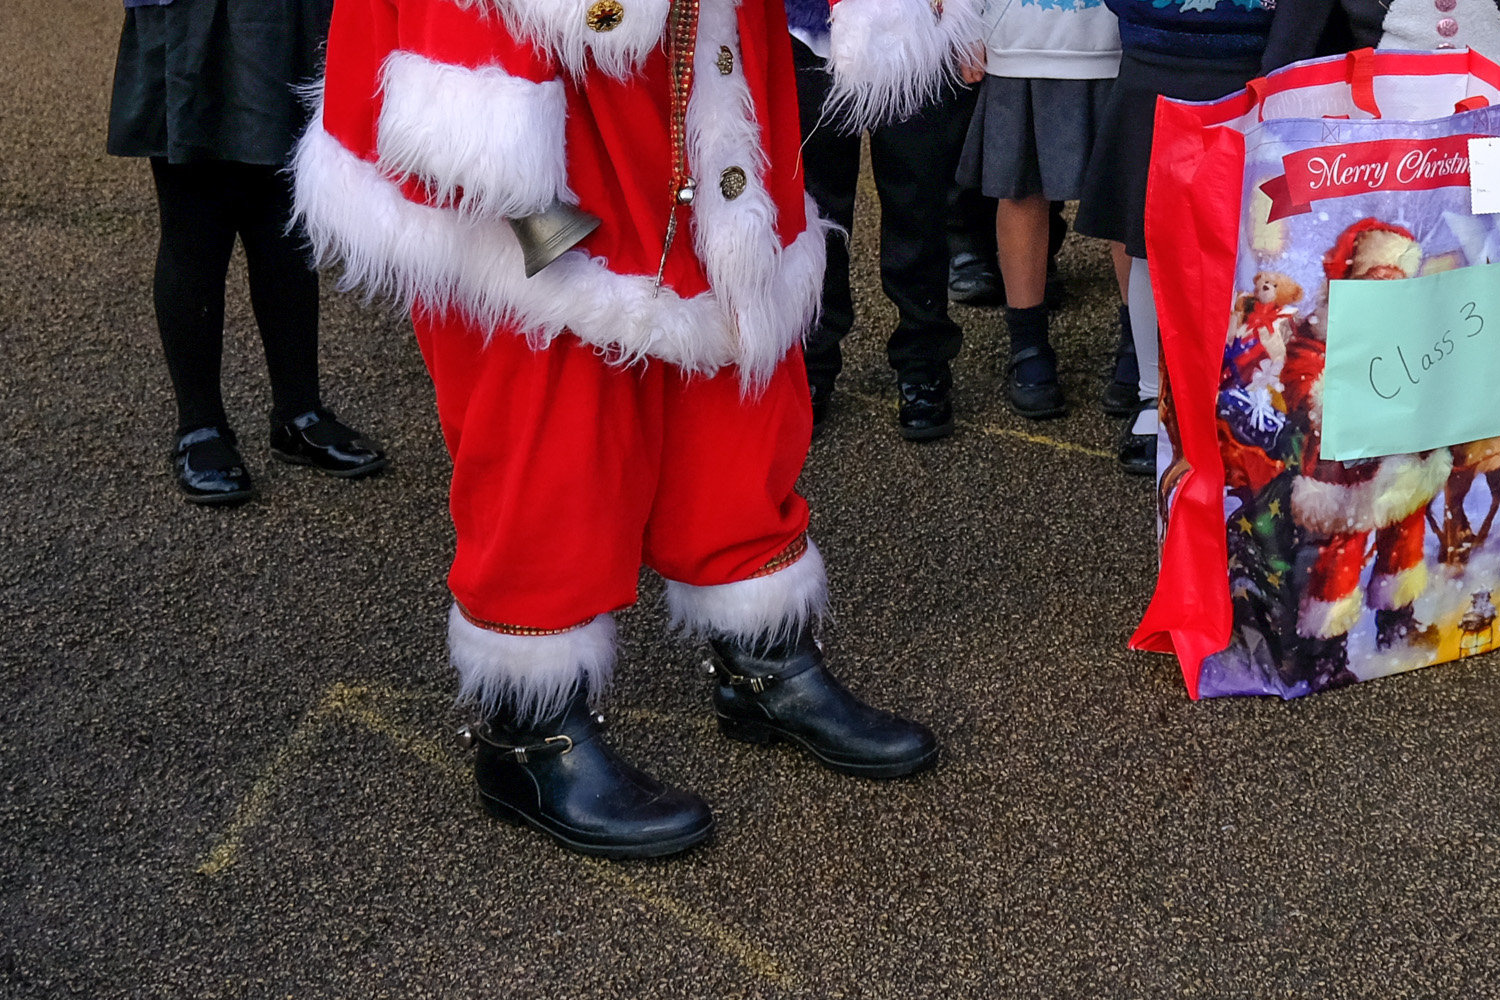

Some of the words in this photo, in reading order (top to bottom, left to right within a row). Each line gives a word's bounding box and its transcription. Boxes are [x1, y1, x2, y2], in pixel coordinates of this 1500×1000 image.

[1307, 153, 1389, 189] Merry
[1396, 148, 1471, 184] Christm
[1369, 329, 1455, 399] Class
[1459, 301, 1484, 338] 3
